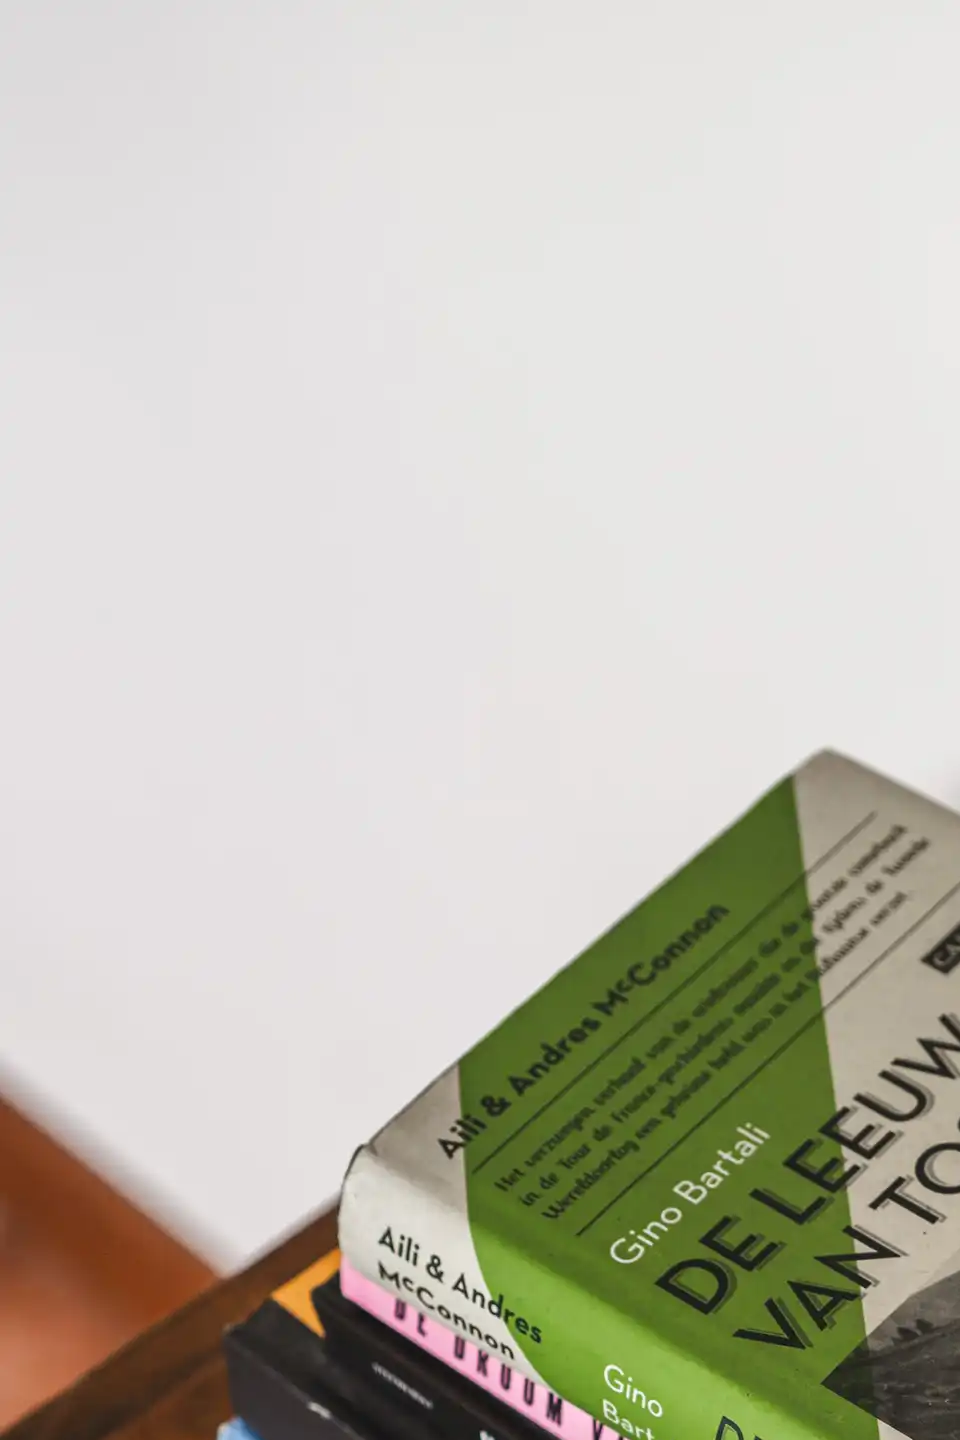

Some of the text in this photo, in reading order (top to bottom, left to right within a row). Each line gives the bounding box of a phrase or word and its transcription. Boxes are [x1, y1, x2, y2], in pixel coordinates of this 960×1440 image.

[437, 1113, 487, 1159] Aili
[480, 1095, 512, 1118] &
[507, 1017, 602, 1096] Andres
[590, 904, 730, 1016] McConnon
[609, 1122, 771, 1266] Gino Bartali
[377, 1261, 515, 1360] McConnon
[378, 1226, 543, 1344] Aili & Andres
[654, 1214, 787, 1316] DE
[731, 1224, 908, 1351] VAN
[603, 1364, 664, 1418] Gino
